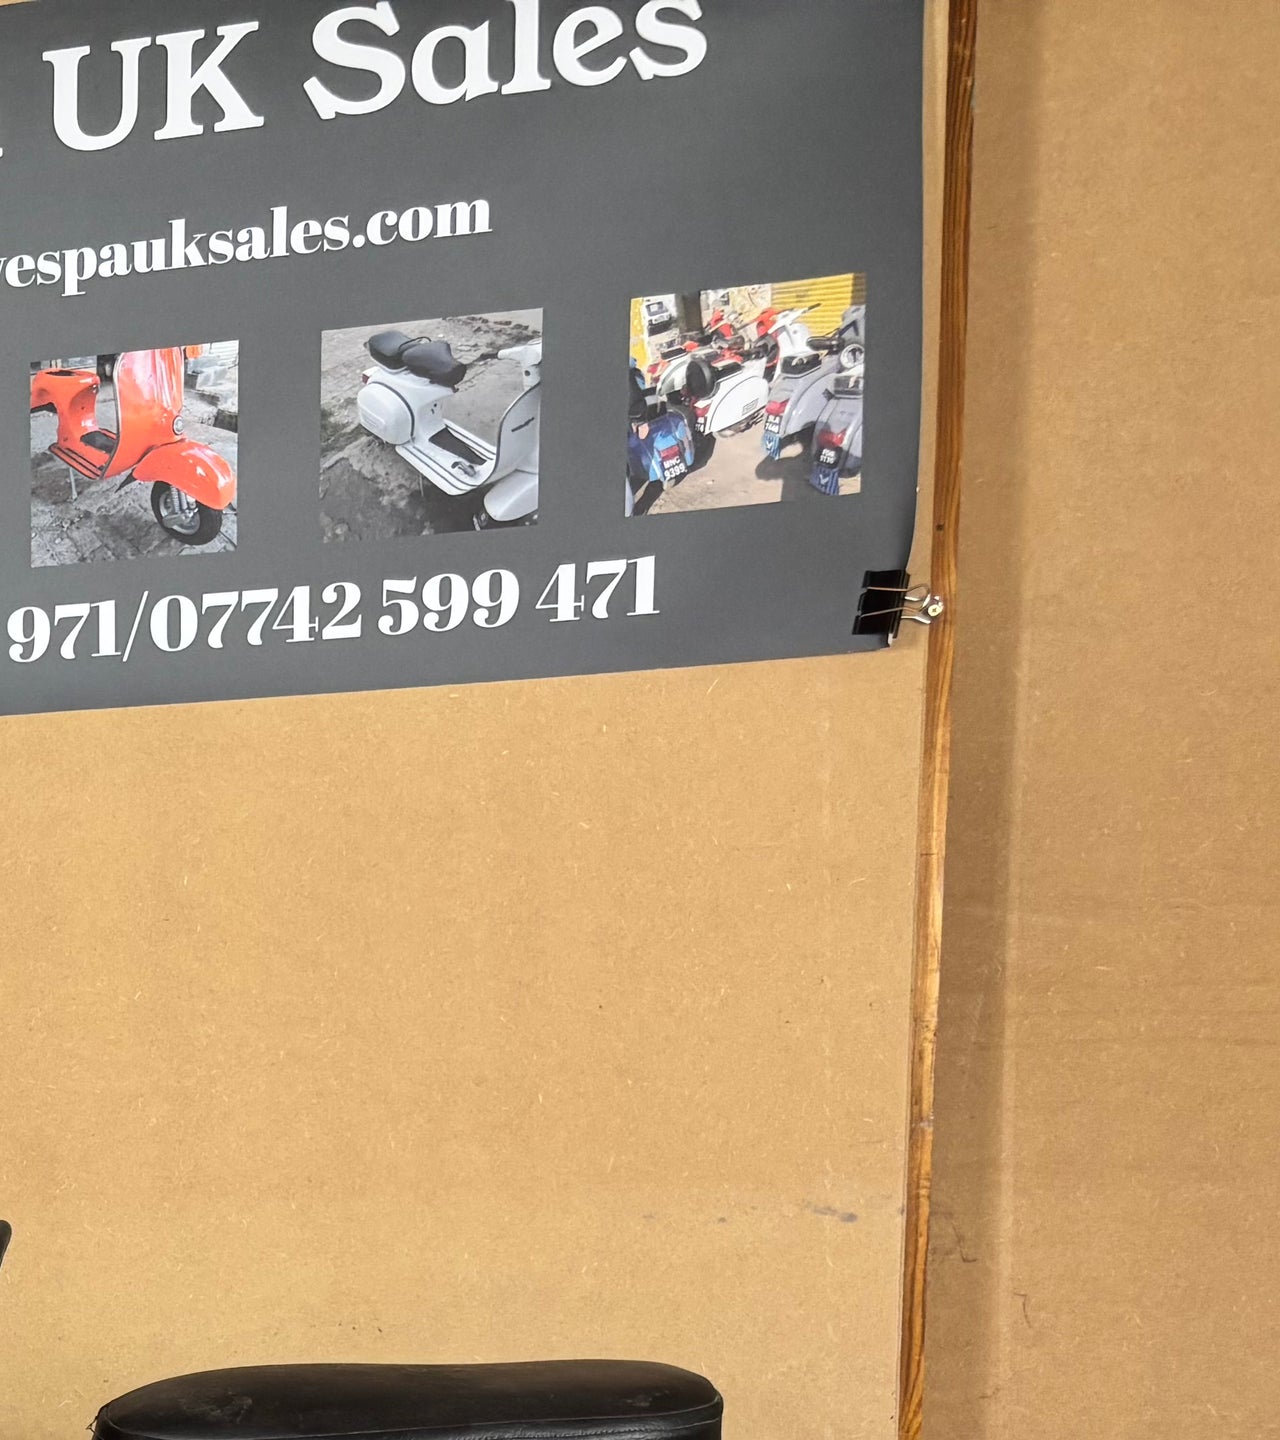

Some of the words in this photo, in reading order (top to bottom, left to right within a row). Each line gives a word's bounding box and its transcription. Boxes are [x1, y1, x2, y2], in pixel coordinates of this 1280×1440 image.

[42, 20, 266, 151] UK
[303, 0, 708, 120] Sales
[7, 581, 362, 663] 971/07742
[377, 569, 520, 636] 599
[535, 555, 661, 622] 471
